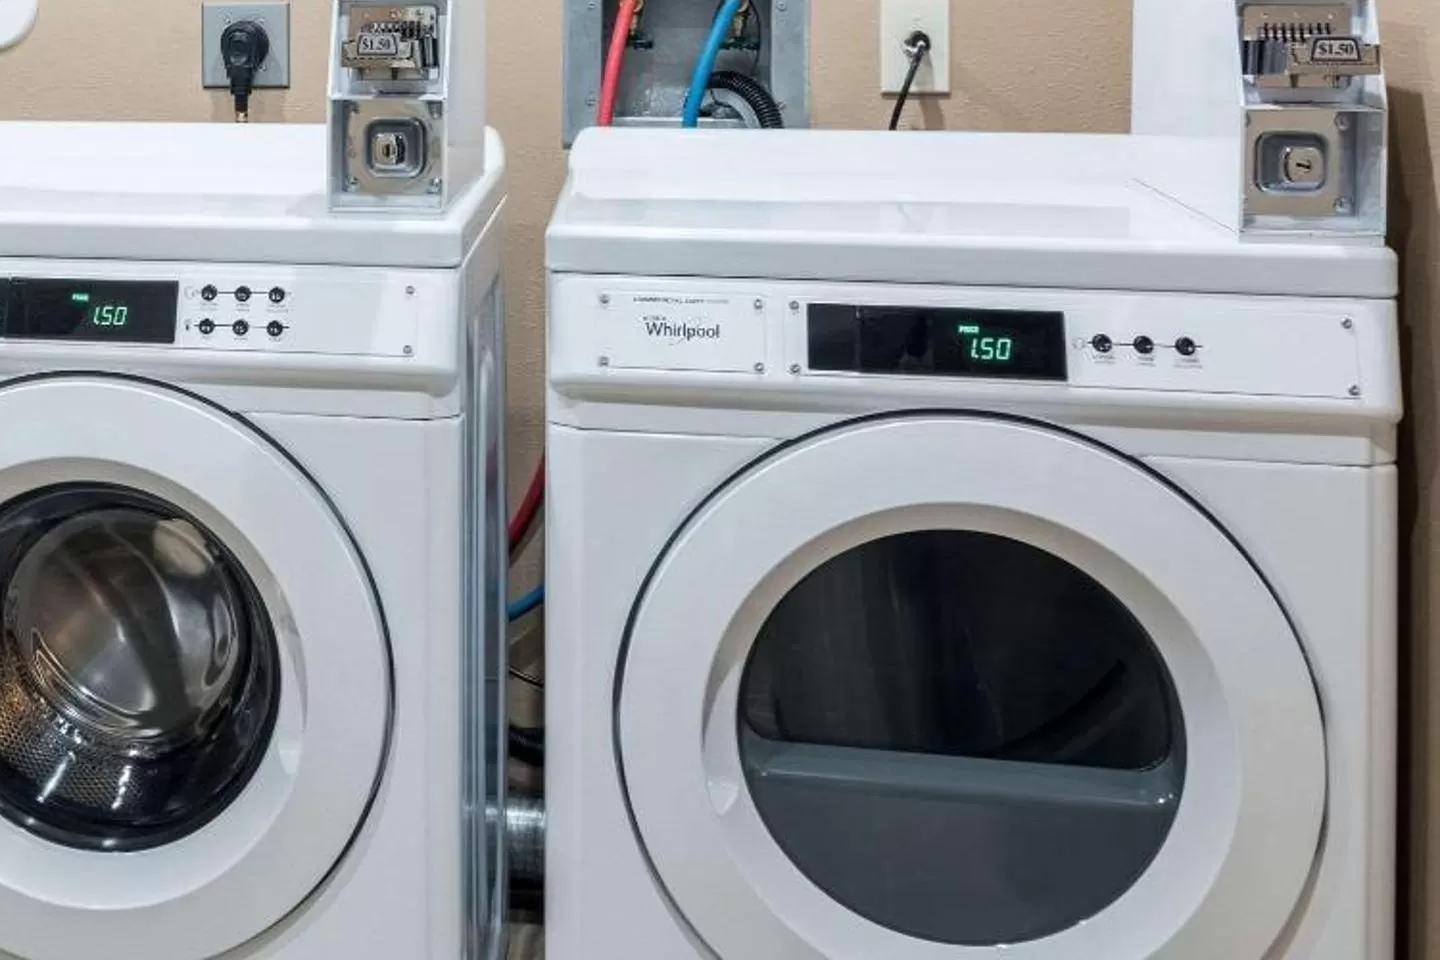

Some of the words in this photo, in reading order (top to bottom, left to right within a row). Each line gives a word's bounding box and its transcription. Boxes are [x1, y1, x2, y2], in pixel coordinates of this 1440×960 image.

[362, 37, 391, 50] $1.50
[1318, 42, 1354, 55] $1.50
[645, 322, 721, 341] Whirlpool
